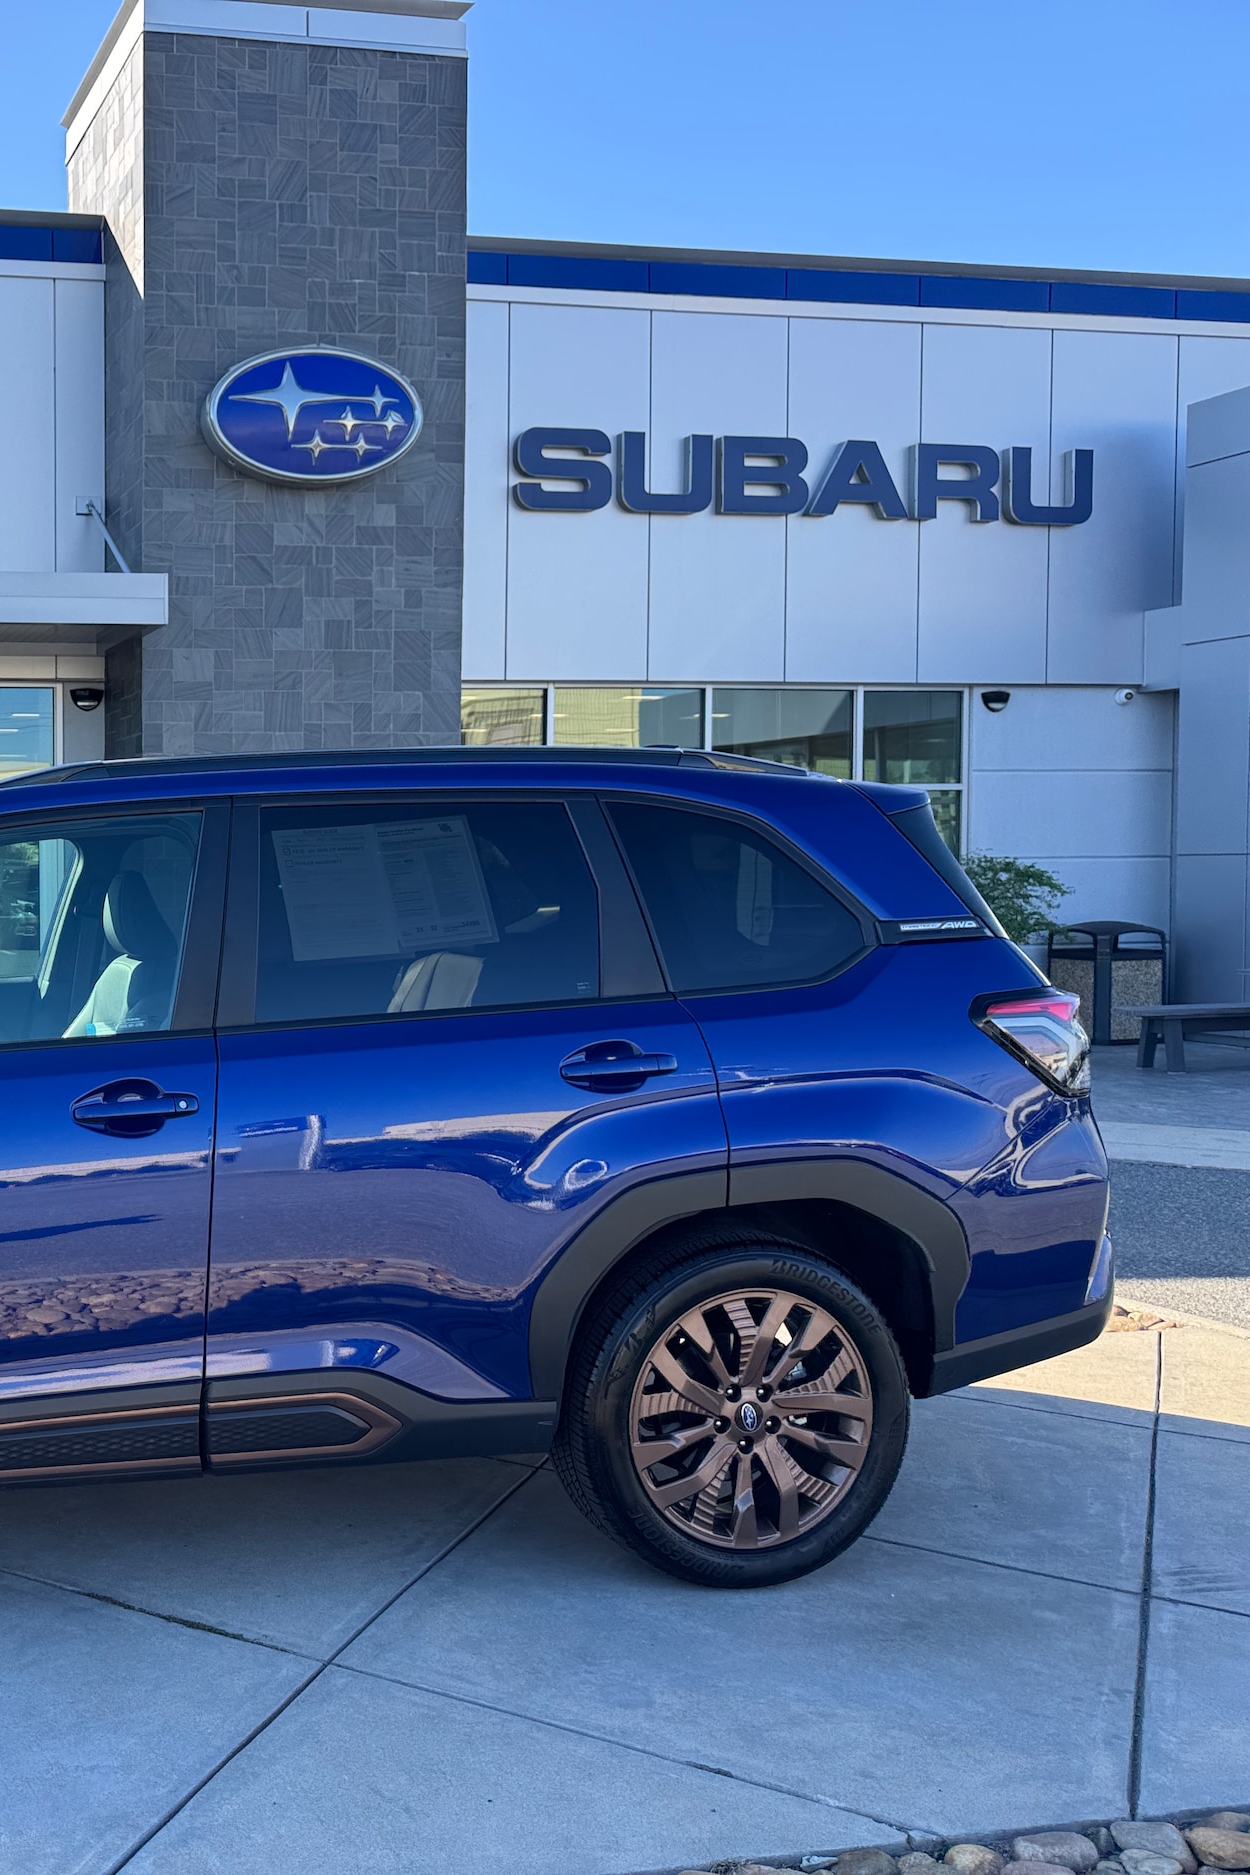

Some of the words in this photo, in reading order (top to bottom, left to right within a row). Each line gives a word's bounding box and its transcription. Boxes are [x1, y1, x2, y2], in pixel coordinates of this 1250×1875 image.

[513, 427, 1094, 526] SUBARU
[941, 921, 977, 929] AWD
[770, 1258, 882, 1336] BRIDGESTONE
